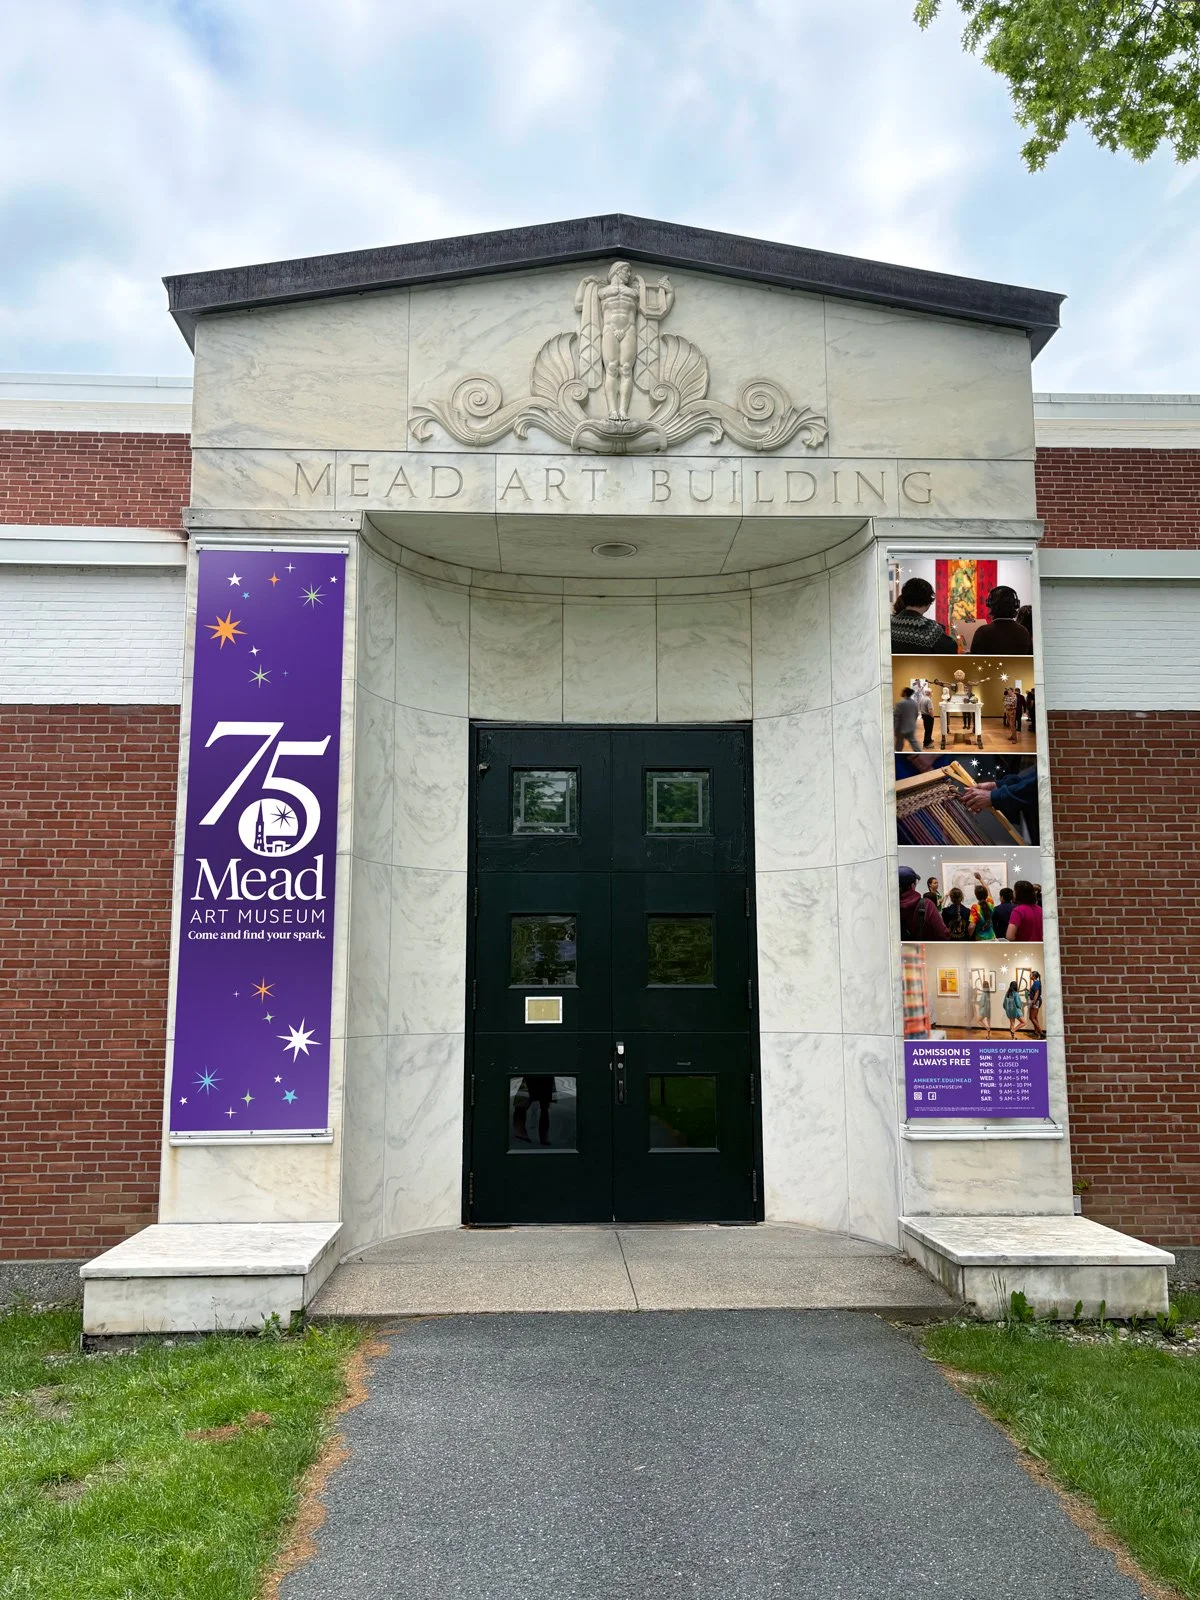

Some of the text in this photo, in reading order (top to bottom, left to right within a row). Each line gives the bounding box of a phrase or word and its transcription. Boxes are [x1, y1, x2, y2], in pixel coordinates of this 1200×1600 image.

[293, 462, 932, 504] MEAD ART BUILDING
[198, 721, 332, 857] 75
[190, 854, 326, 901] Mead
[188, 929, 326, 942] Come and find your spark.
[190, 909, 325, 924] ART MUSEUM
